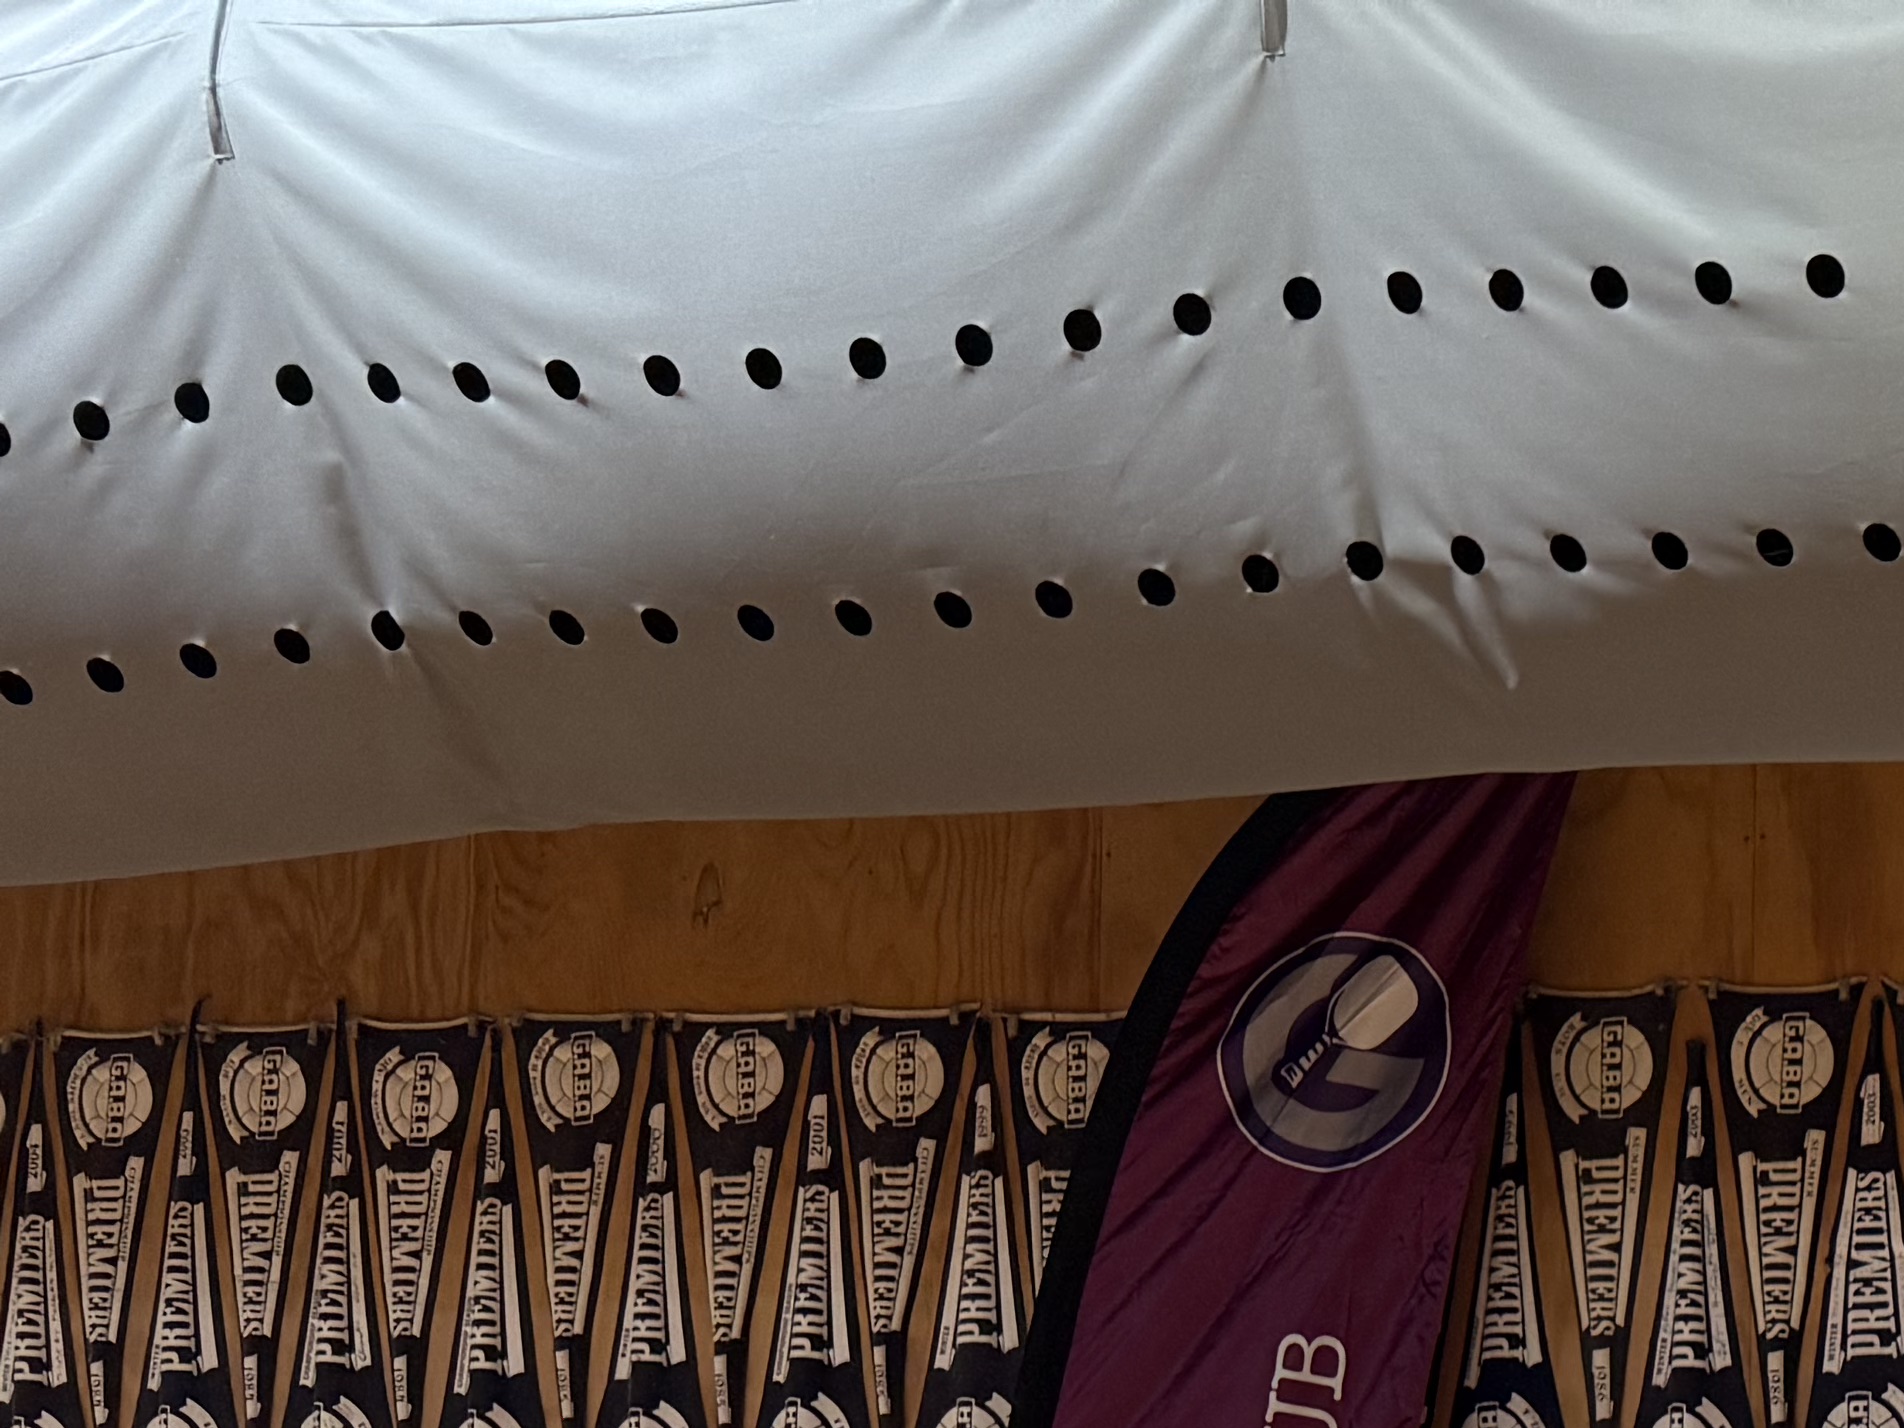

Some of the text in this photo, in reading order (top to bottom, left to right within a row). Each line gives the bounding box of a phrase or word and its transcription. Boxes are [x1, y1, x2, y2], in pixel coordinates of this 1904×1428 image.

[812, 1115, 827, 1157] 2001
[1602, 1023, 1626, 1112] G.A.B.A
[1781, 1018, 1806, 1107] G.A.B.A
[13, 1212, 45, 1385] PREMIERS
[86, 1177, 126, 1342] PREMIERS
[160, 1201, 194, 1372] PREMIERS
[240, 1169, 279, 1338] PREMIERS
[315, 1191, 351, 1365] PREMIERS
[390, 1168, 432, 1337] PREMIERS
[468, 1197, 502, 1372] PREMIERS
[553, 1169, 591, 1337] PREMIERS
[629, 1192, 664, 1362] PREMIERS
[712, 1171, 750, 1341] PREMIERS
[791, 1184, 830, 1364] PREMIERS
[873, 1164, 913, 1333] PREMIERS
[956, 1170, 998, 1349] PREMIERS
[1481, 1179, 1524, 1364] PREMIERS
[1578, 1153, 1624, 1336] PREMIERS
[1672, 1183, 1710, 1368] PREMIERS
[1755, 1157, 1801, 1339] PREMIERS
[1846, 1170, 1898, 1359] PREMIERS
